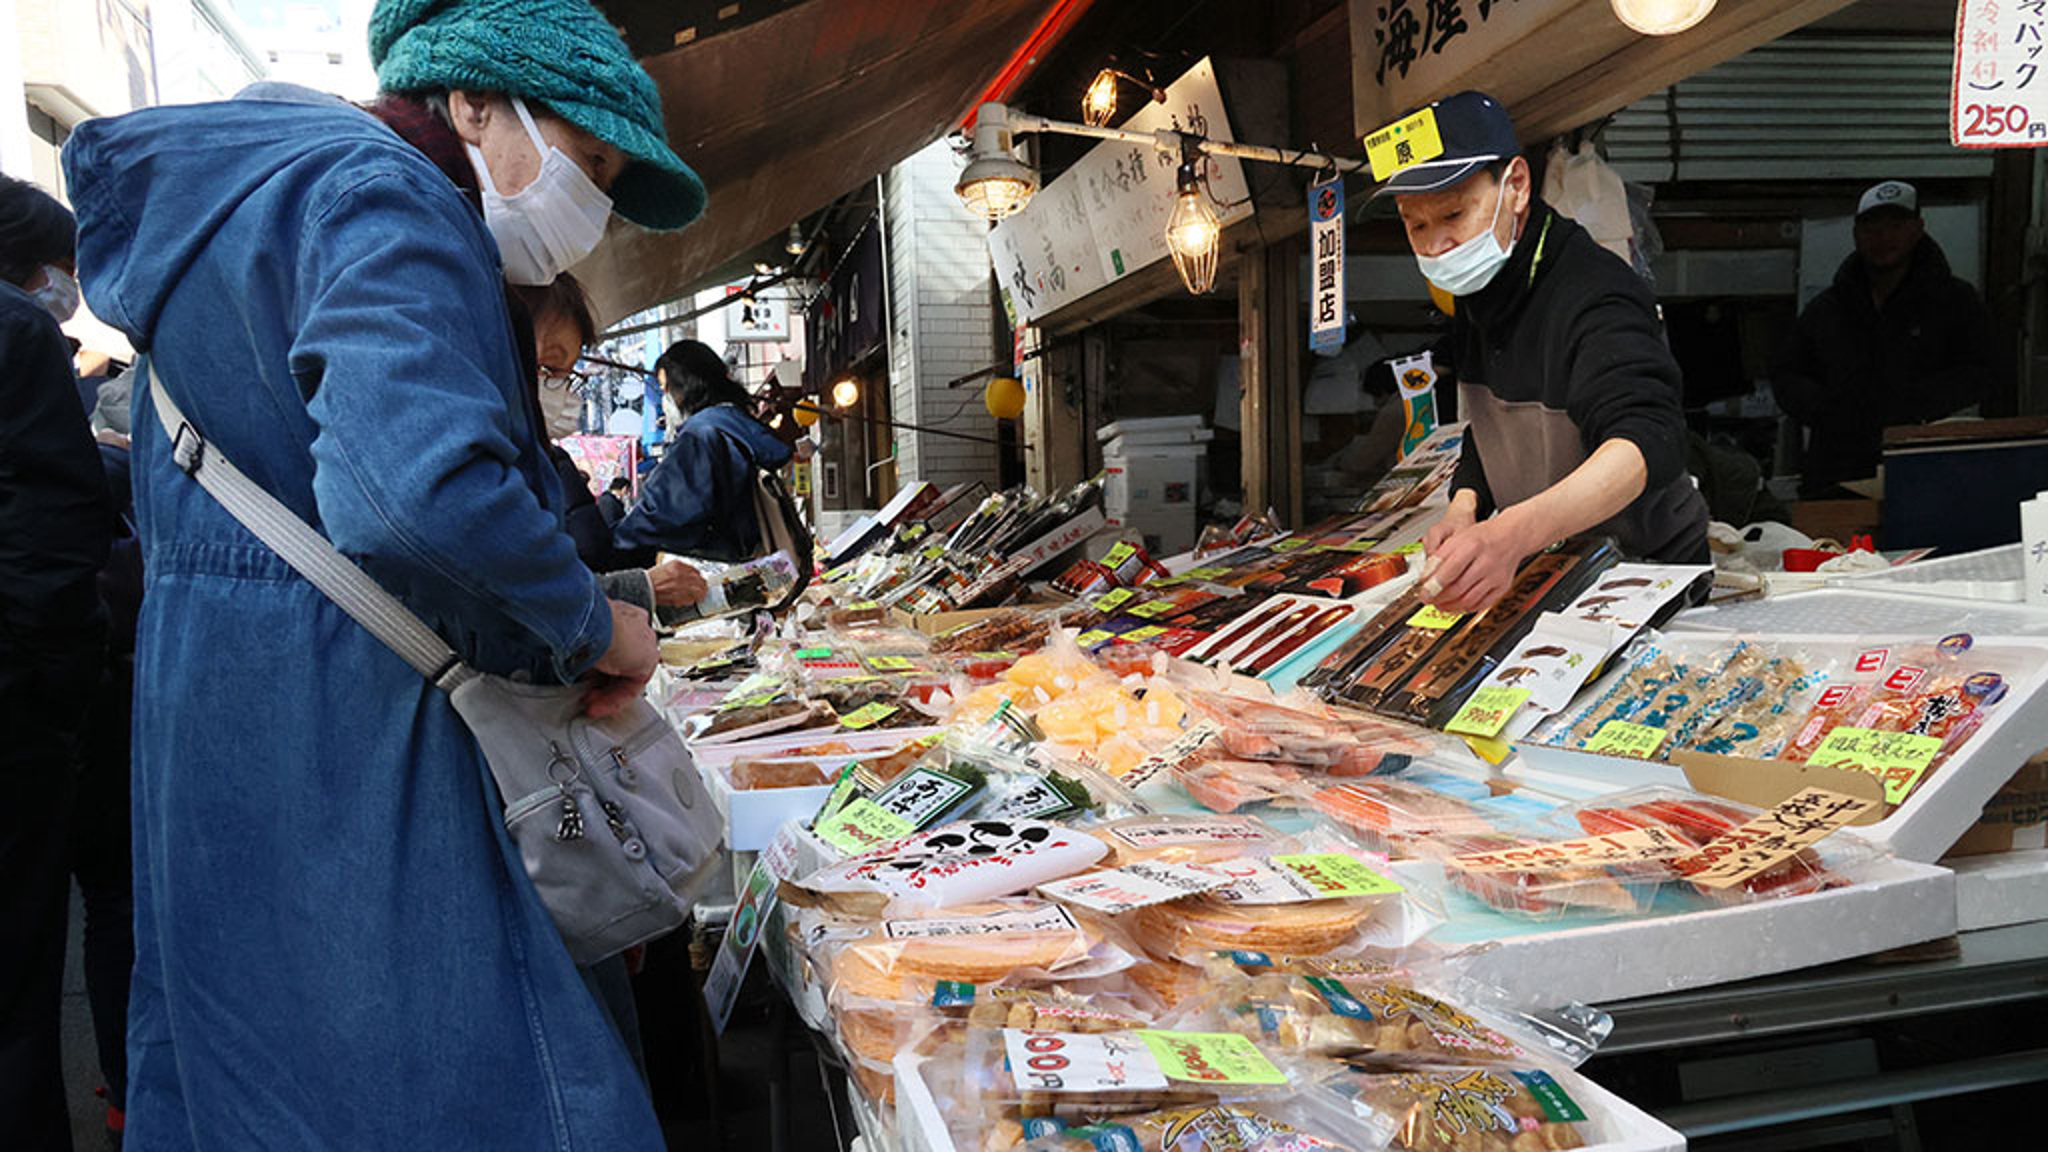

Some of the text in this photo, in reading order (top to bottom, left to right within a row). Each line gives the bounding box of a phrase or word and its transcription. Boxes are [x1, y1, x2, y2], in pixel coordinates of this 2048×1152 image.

[1375, 0, 1498, 86] 海産
[1963, 104, 2047, 138] 250円
[1318, 229, 1337, 323] 加盟店
